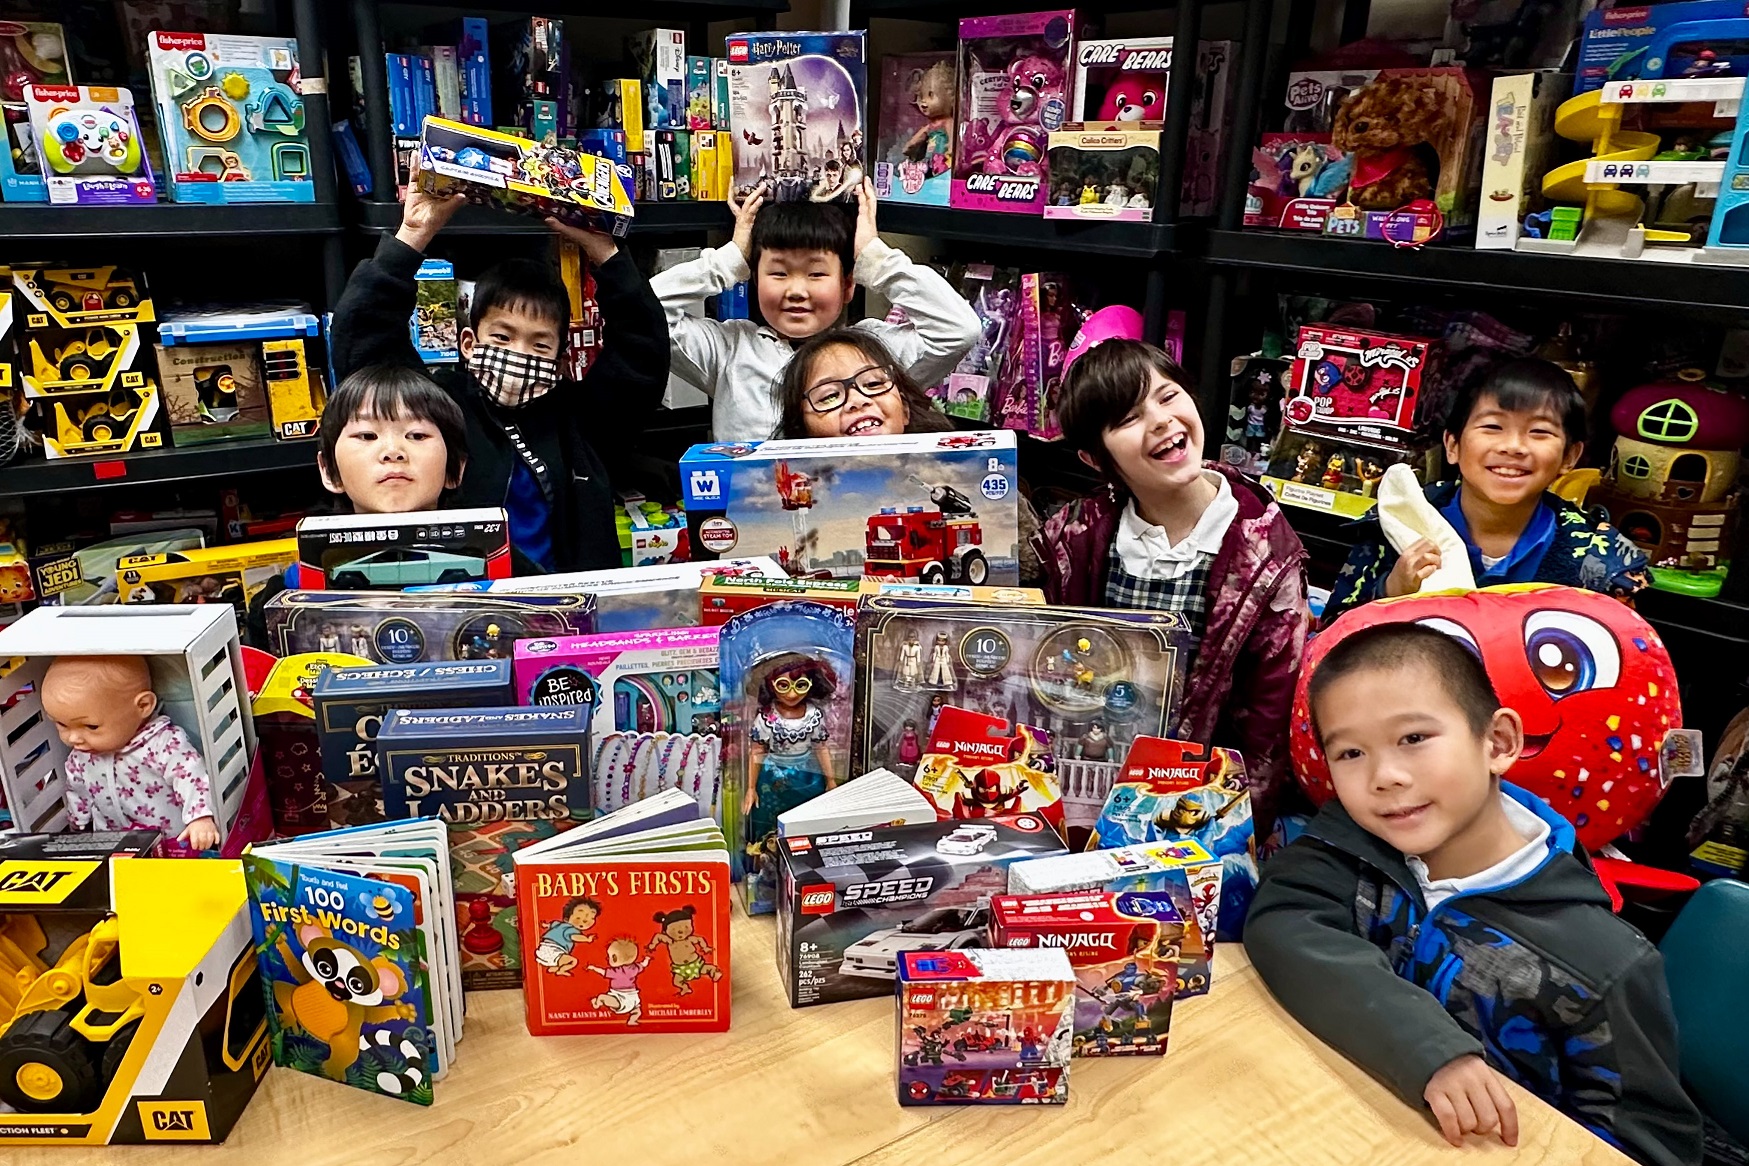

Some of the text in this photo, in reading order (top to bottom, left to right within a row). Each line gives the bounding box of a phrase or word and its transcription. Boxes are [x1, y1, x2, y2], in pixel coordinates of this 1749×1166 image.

[159, 35, 203, 46] fisher-price
[730, 46, 749, 55] LEGO
[752, 40, 802, 57] Harry Potter
[1080, 44, 1173, 69] CARE BEARS
[35, 88, 78, 98] fisher-price
[1290, 82, 1322, 100] Pets
[967, 173, 1038, 200] CARE BEARS
[1327, 216, 1360, 234] PETS
[417, 267, 451, 276] playmobil
[172, 353, 246, 366] Construction
[1001, 396, 1028, 415] Barbie
[1314, 396, 1333, 408] POP
[284, 421, 308, 436] CAT
[144, 436, 158, 444] CAT
[982, 478, 1007, 491] 435
[128, 555, 156, 564] CAT
[41, 560, 77, 576] YOUNG
[43, 567, 79, 588] JEDI
[725, 576, 848, 588] North Pole Express
[389, 628, 409, 644] 10
[571, 636, 651, 649] HEADBANDS
[667, 633, 719, 642] BARRET
[976, 638, 997, 654] 10
[336, 669, 416, 681] ÉCHECS
[434, 665, 498, 676] CHESS
[546, 676, 571, 694] BE
[1114, 684, 1125, 697] 5
[399, 714, 486, 725] LADDERS
[504, 710, 576, 722] SNAKES
[952, 740, 1006, 758] NINJAGO
[923, 764, 938, 773] 6+
[1146, 767, 1201, 781] NINJAGO
[404, 761, 568, 797] SNAKES
[468, 789, 507, 801] AND
[1113, 793, 1131, 804] 6+
[405, 795, 571, 824] LADDERS
[0, 869, 72, 892] CAT
[536, 870, 712, 898] BABY'S FIRSTS
[844, 877, 934, 900] SPEED
[304, 886, 345, 911] 100
[801, 889, 835, 907] LEGO
[874, 891, 929, 904] CHAMPIONS
[260, 902, 401, 950] First Words
[800, 942, 818, 953] 8+
[1008, 932, 1119, 950] LEGO NINJAGO
[798, 970, 813, 978] 262
[798, 976, 826, 987] pcs/pzs
[150, 985, 162, 994] 2+
[911, 994, 933, 1004] LEGO
[648, 1009, 713, 1017] MICHAEL EMBERLEY
[255, 1044, 269, 1070] CAT
[152, 1110, 194, 1131] CAT
